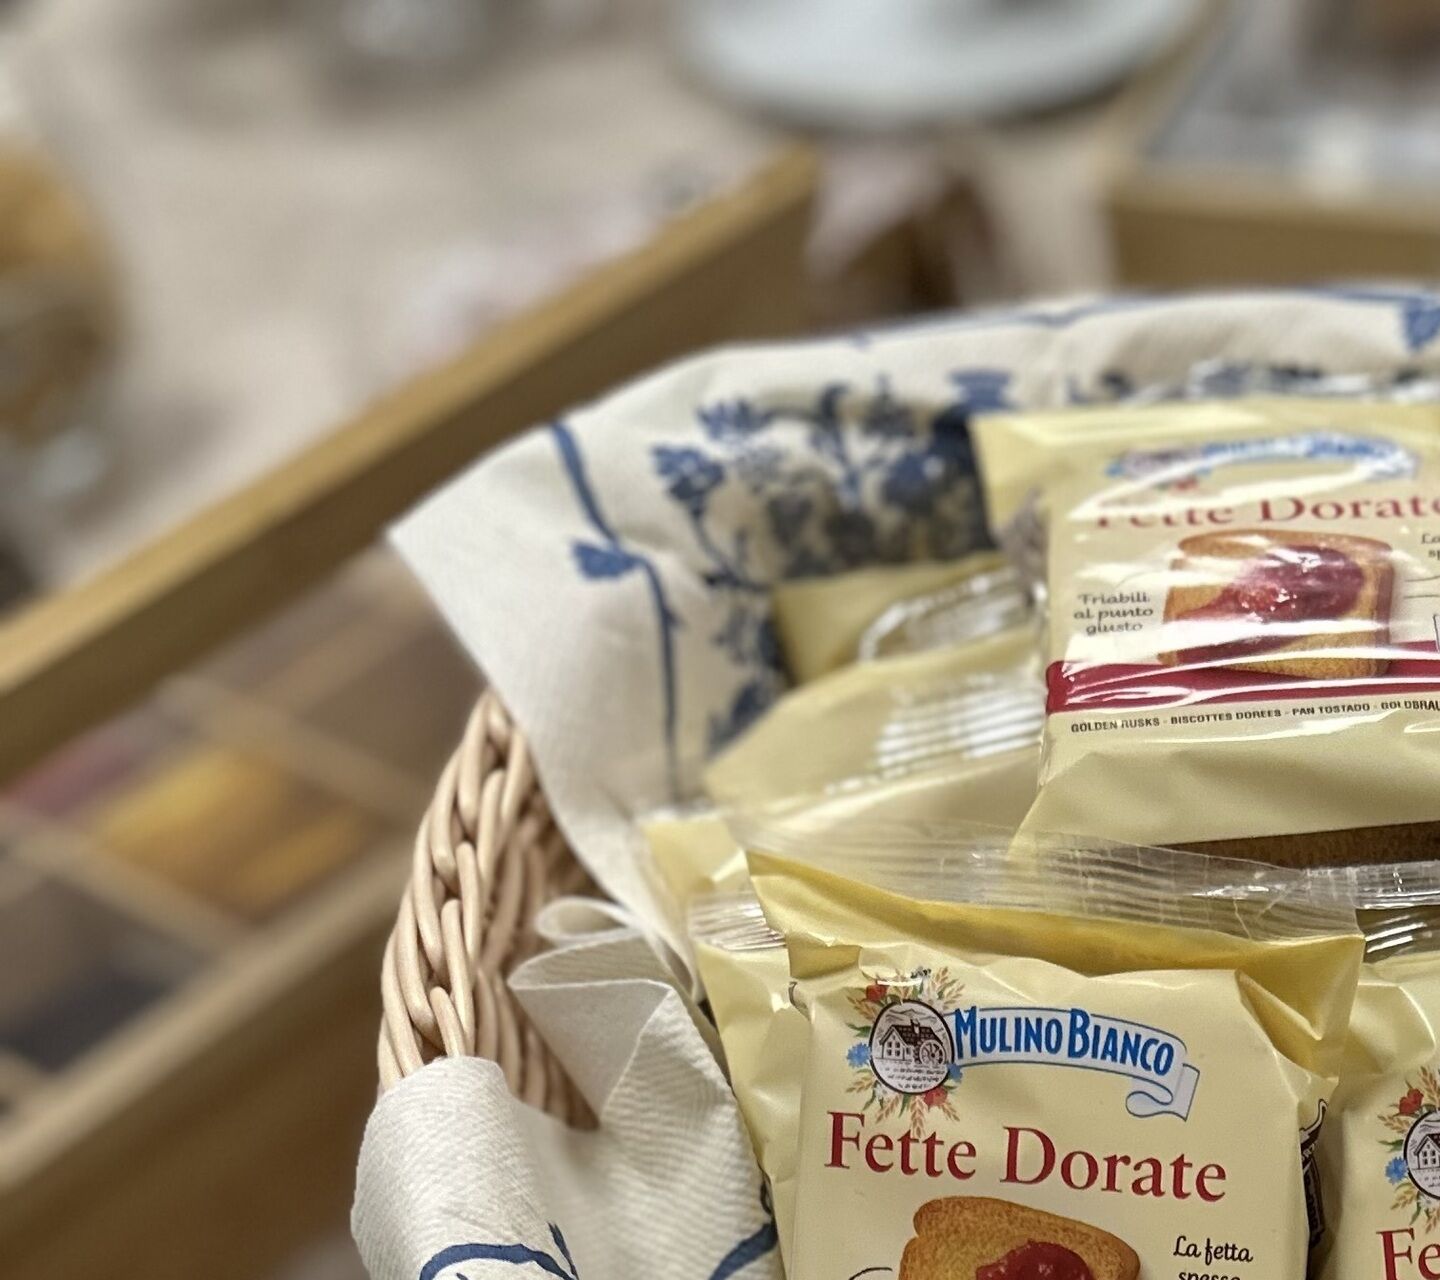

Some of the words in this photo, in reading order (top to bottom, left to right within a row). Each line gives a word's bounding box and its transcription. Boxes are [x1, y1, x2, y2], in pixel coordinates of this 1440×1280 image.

[1077, 592, 1150, 606] Friabili
[1074, 607, 1093, 619] al
[1096, 606, 1154, 624] punto
[1085, 620, 1144, 636] giusto
[1070, 720, 1118, 733] GOLDEN
[1120, 717, 1160, 730] RUSKS
[1170, 712, 1233, 726] BISCOTTES
[1235, 709, 1281, 722] DOREES
[1292, 706, 1315, 717] PAN
[1318, 703, 1371, 716] TOSTADO
[954, 1005, 1060, 1060] MULINO
[1067, 1008, 1175, 1077] BIANCO
[825, 1110, 977, 1182] Fette
[1000, 1126, 1227, 1203] Dorate
[1173, 1236, 1201, 1258] La
[1202, 1240, 1253, 1264] fetta
